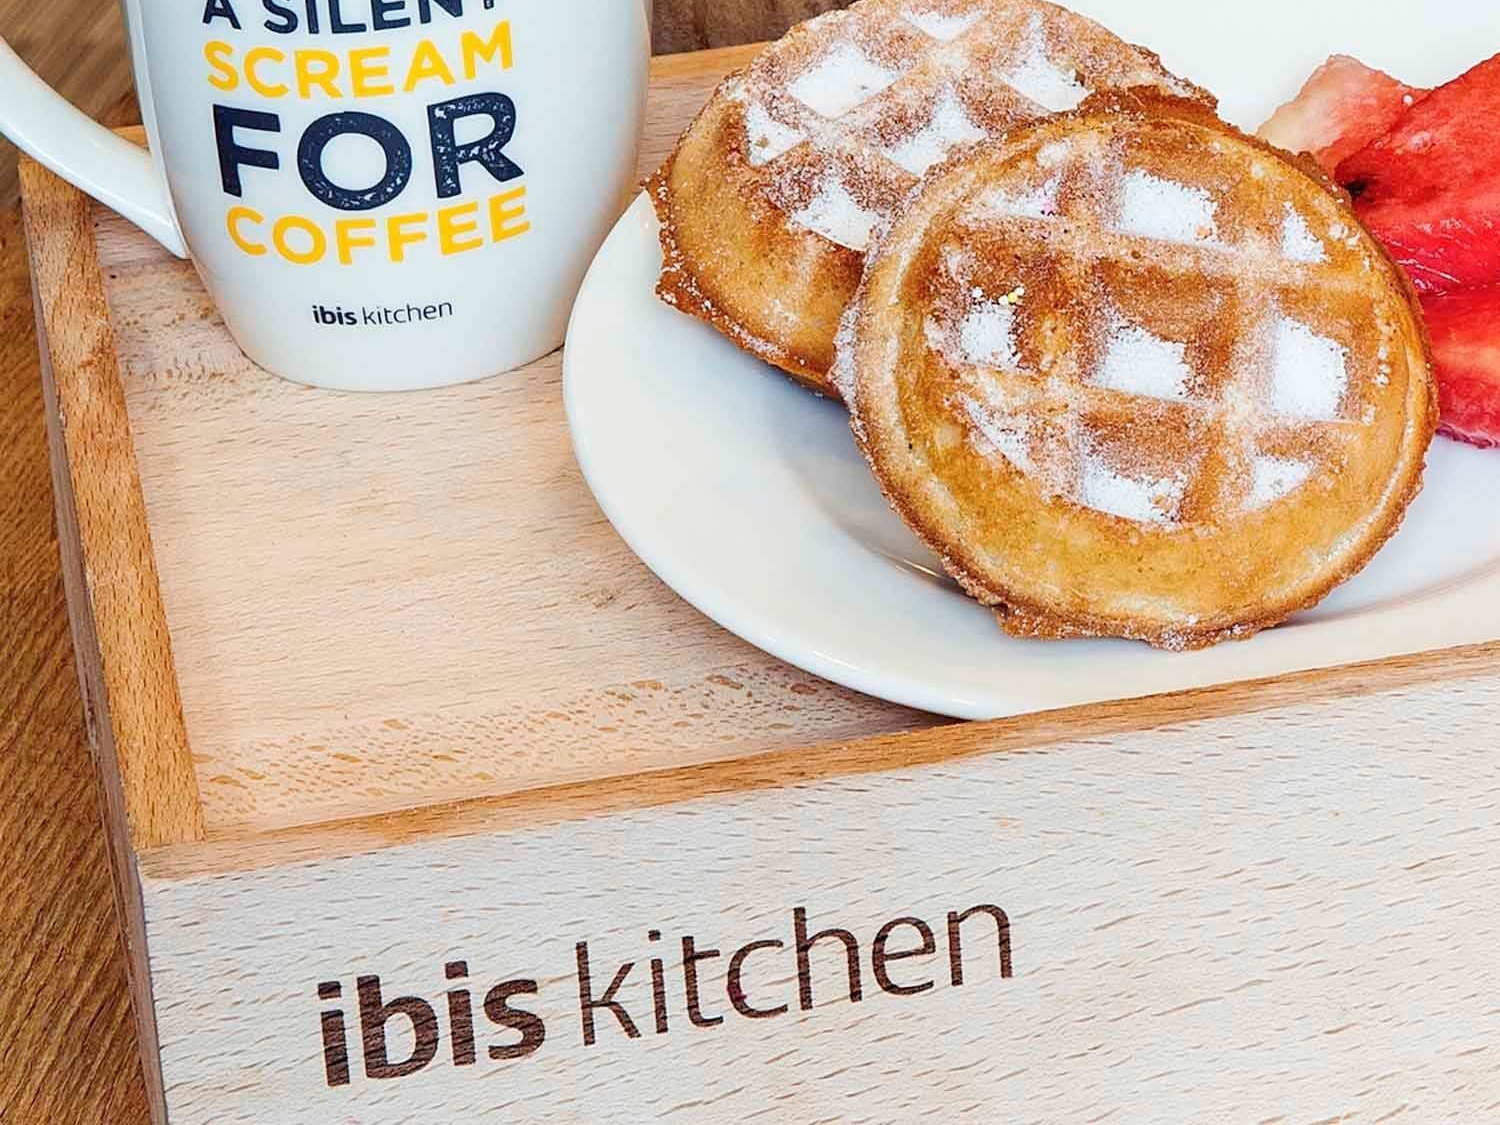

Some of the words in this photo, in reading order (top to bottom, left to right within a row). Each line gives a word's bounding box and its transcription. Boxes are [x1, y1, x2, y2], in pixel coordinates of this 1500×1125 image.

[203, 20, 514, 100] SCREAM
[212, 91, 525, 212] FOR
[226, 186, 531, 266] COFFEE
[311, 303, 359, 327] ibis
[363, 300, 453, 327] kitchen
[317, 959, 547, 1089] ibis
[575, 903, 1014, 1047] kitchen
